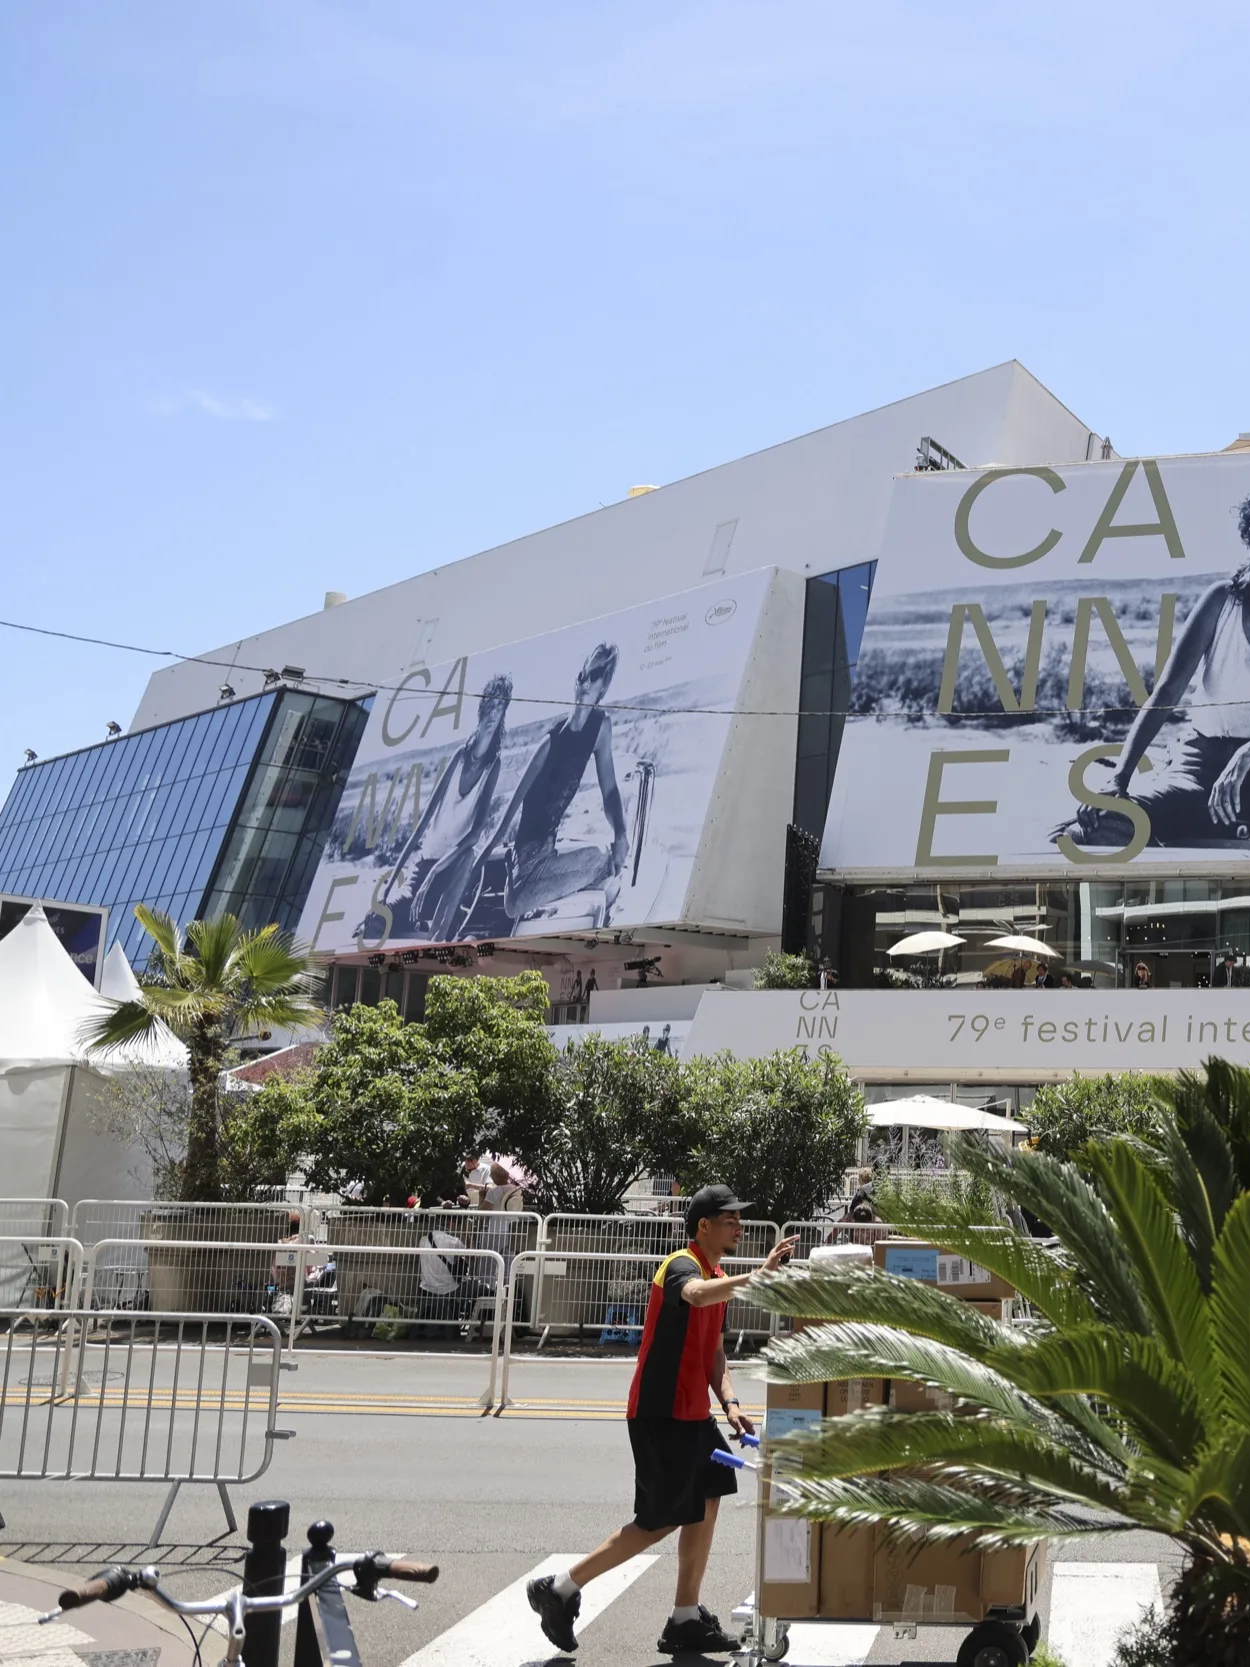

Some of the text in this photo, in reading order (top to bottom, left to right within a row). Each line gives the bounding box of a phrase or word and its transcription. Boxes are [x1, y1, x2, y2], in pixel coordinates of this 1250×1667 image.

[954, 461, 1186, 570] CA
[937, 592, 1177, 713] NN
[381, 656, 469, 747] CA
[914, 744, 1153, 867] ES
[309, 868, 405, 956] ES
[796, 1016, 838, 1038] NN
[800, 991, 840, 1011] CA
[1021, 1014, 1168, 1043] festival
